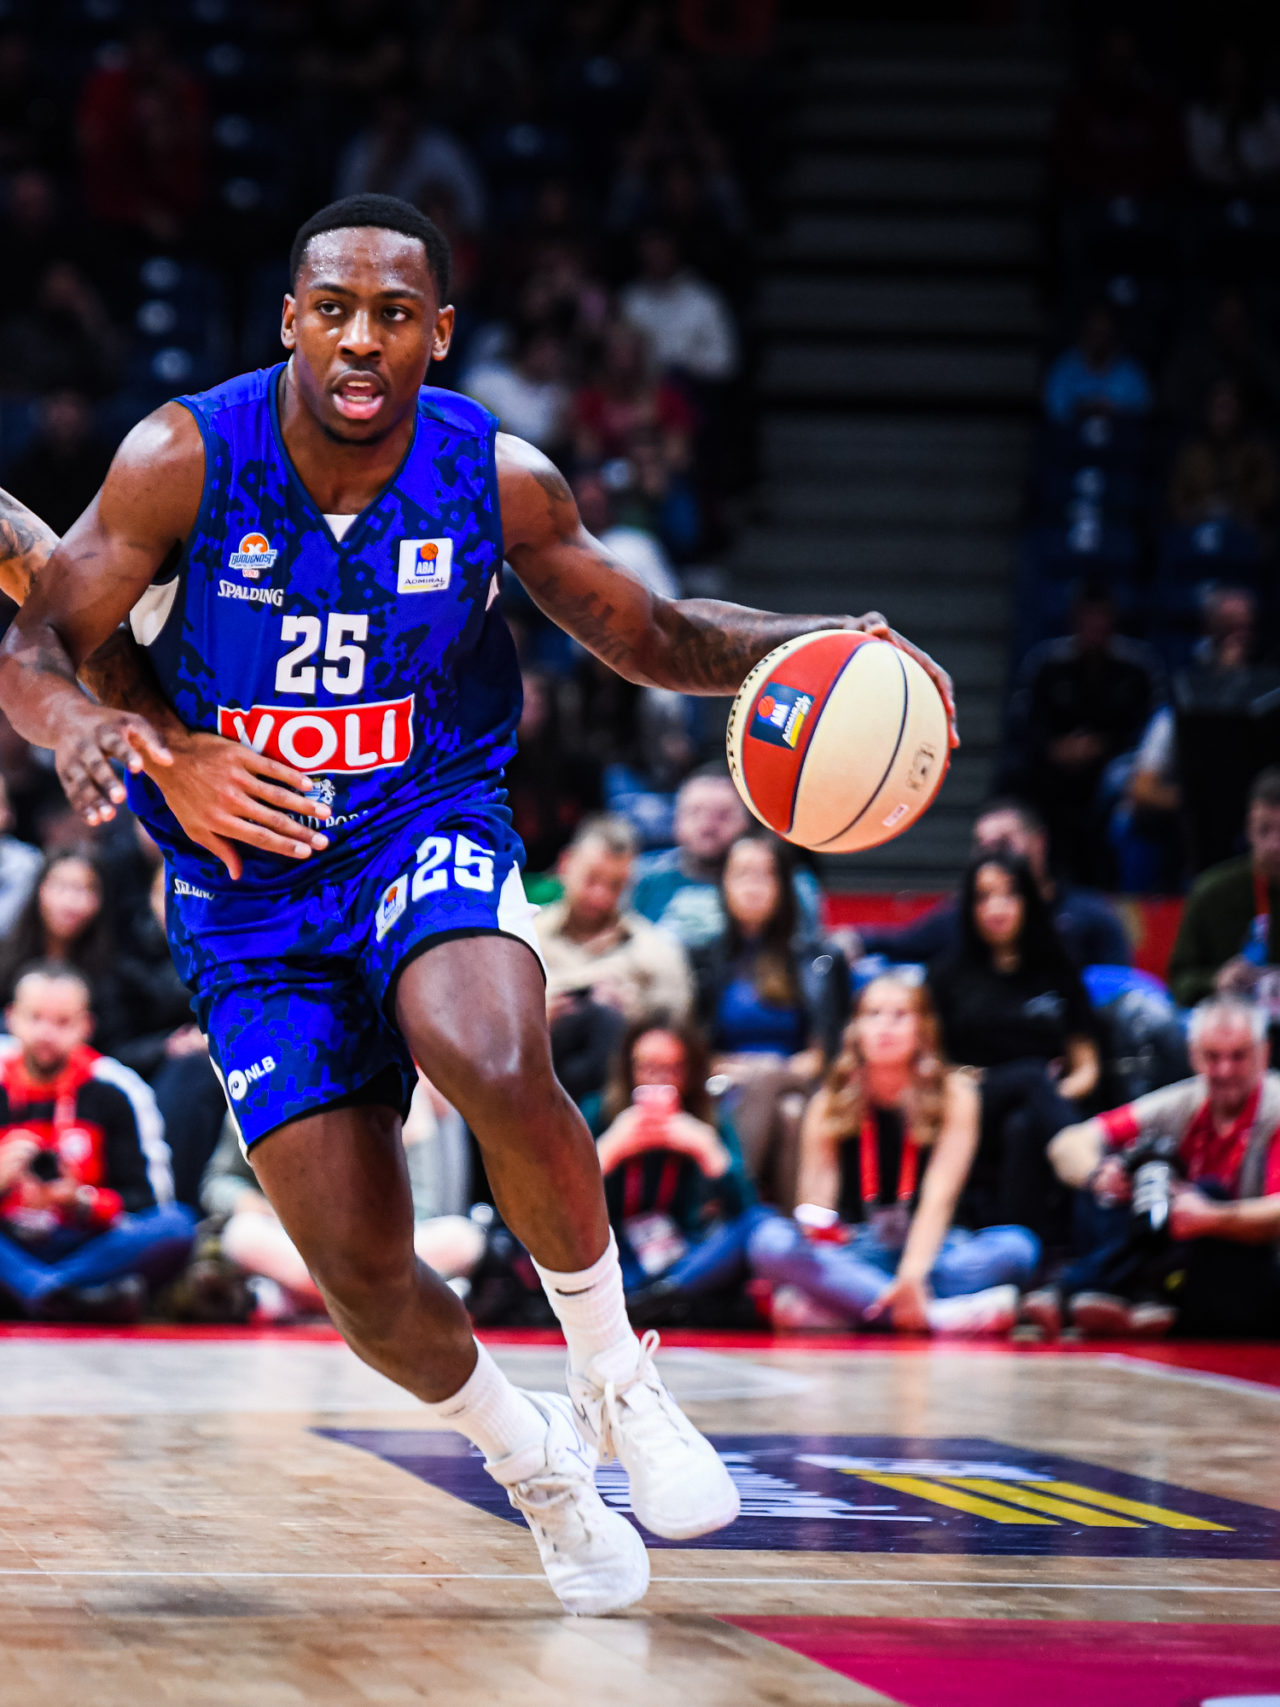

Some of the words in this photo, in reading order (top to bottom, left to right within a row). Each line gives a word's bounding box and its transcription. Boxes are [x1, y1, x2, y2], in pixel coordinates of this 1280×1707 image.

[416, 561, 434, 574] ABA
[217, 579, 284, 606] SPALDING
[275, 612, 369, 694] 25
[233, 709, 397, 769] VOLI
[411, 833, 496, 902] 25
[244, 1055, 276, 1084] NLB
